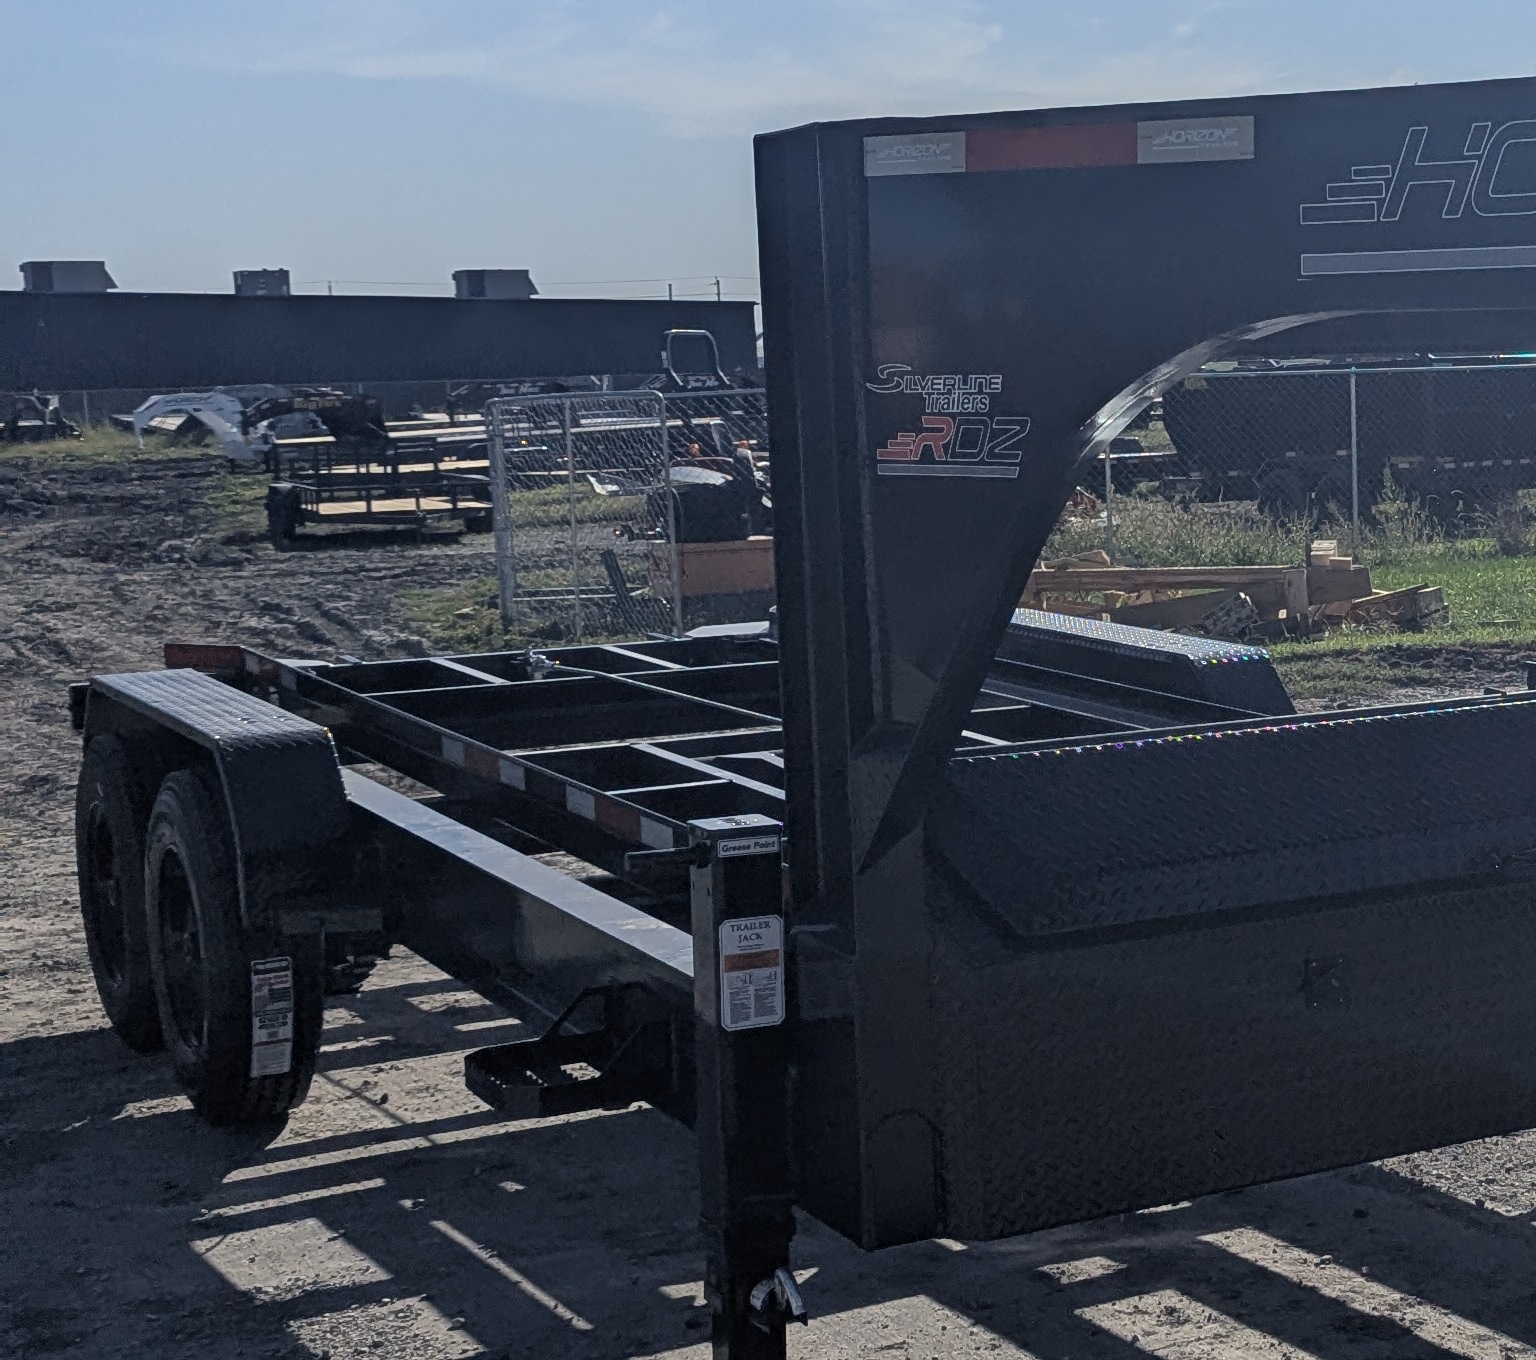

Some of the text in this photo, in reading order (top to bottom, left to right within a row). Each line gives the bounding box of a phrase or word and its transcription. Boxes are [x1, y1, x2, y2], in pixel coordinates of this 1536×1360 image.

[866, 363, 1003, 393] SILVERLINE
[922, 392, 990, 413] Trailers
[910, 415, 1031, 462] RDZ
[729, 920, 772, 933] TRAILER
[738, 932, 763, 944] JACK
